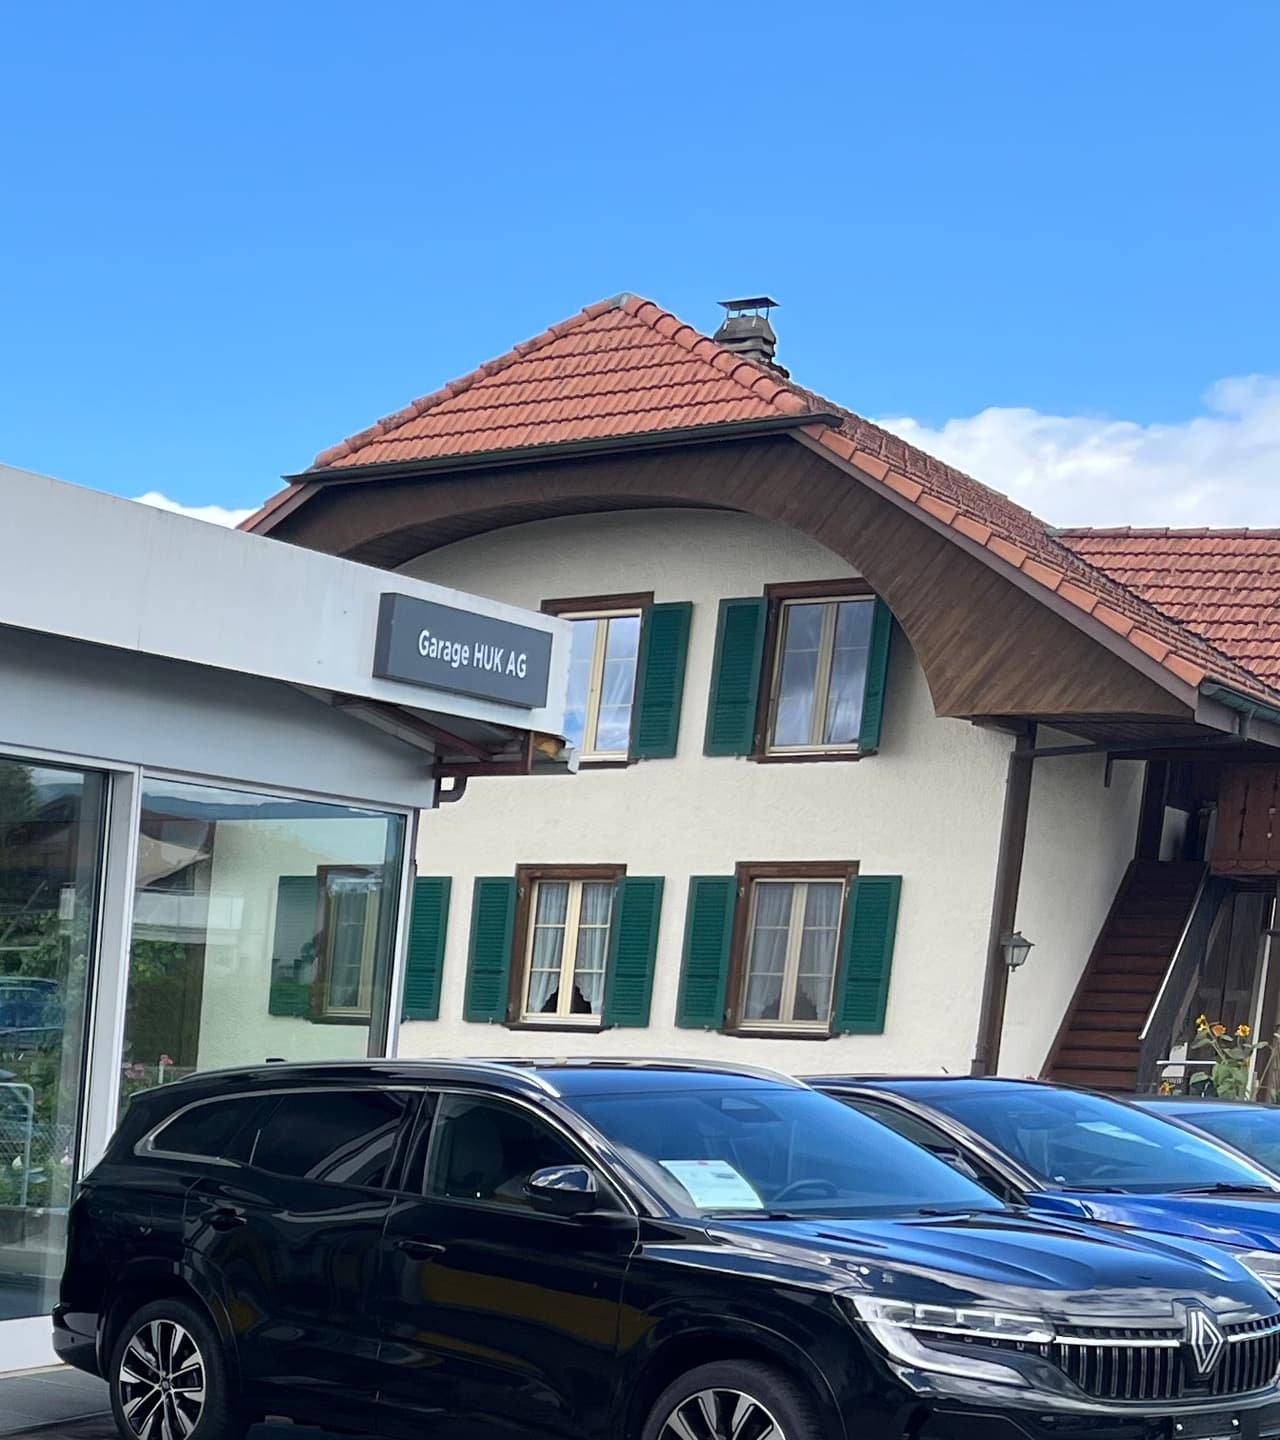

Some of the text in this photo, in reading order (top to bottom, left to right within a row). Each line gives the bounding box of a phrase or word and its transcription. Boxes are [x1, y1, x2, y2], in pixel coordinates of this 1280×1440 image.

[418, 629, 527, 679] Garage HUK AG
